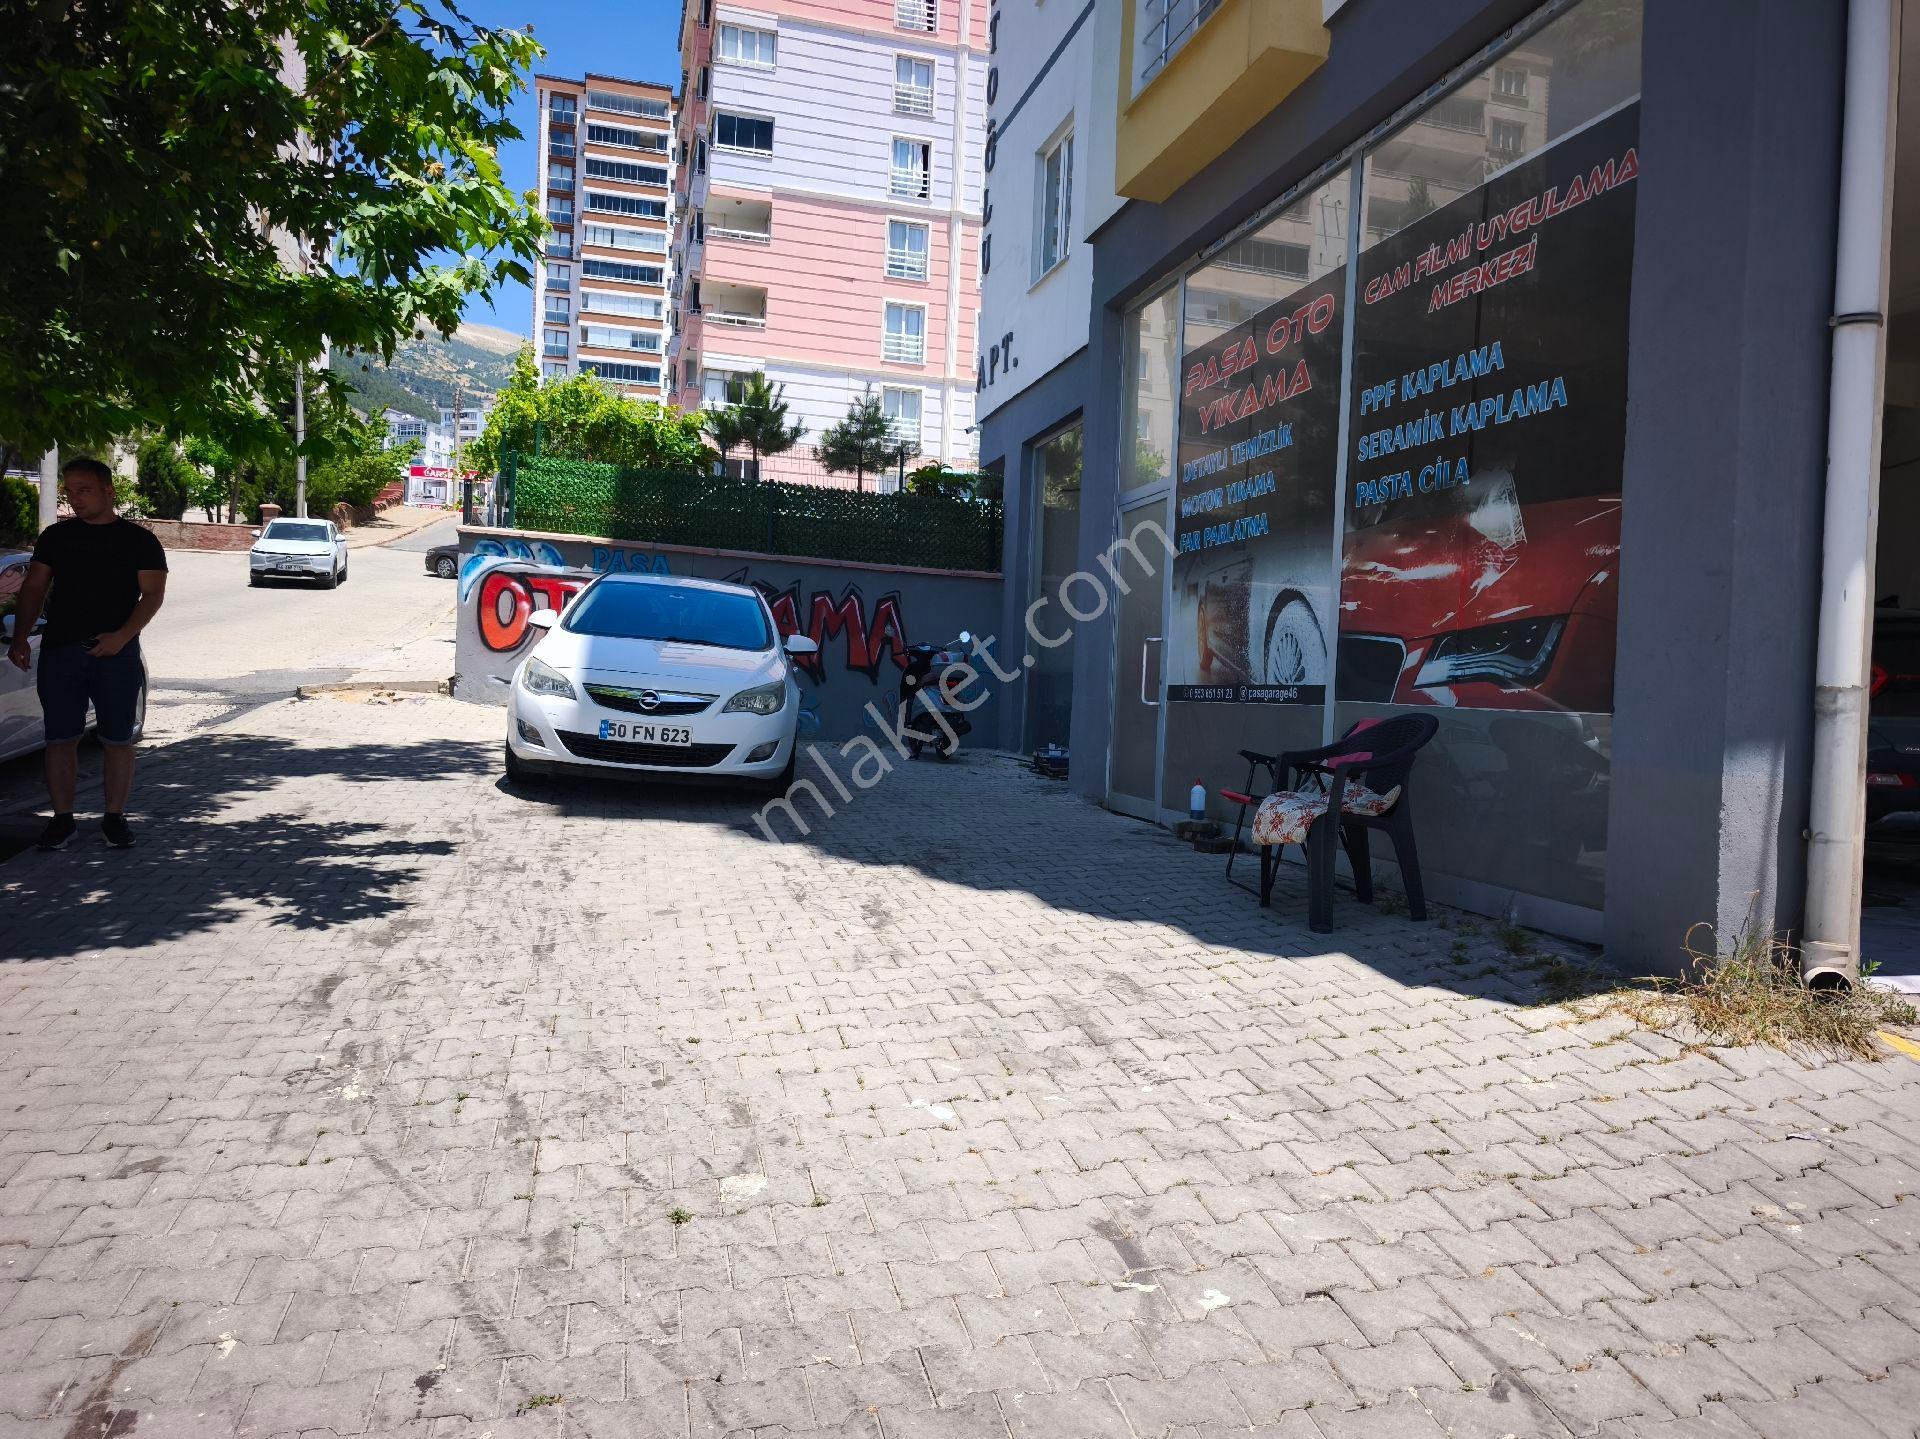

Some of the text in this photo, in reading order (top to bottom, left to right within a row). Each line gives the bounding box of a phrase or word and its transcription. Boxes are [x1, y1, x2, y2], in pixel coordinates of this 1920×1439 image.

[981, 0, 1001, 275] TOĞLU
[1363, 147, 1639, 305] CAM FİLMİ UYGULAMA
[1427, 232, 1538, 314] MERKEZİ
[975, 331, 1019, 394] APT.
[1184, 293, 1336, 398] PAŞA OTO
[1359, 340, 1505, 416] PPF KAPLAMA
[1198, 358, 1313, 435] YIKAMA
[1357, 376, 1568, 462] SERAMİK KAPLAMA
[1182, 420, 1294, 484] DETAYLI TEMİZLİK
[1355, 455, 1471, 509] PASTA CİLA
[1181, 470, 1276, 519] MOTOR YIKAMA
[1178, 512, 1271, 554] FAR PARLATMA
[477, 569, 598, 653] OT
[607, 722, 627, 739] 50
[632, 725, 656, 741] FN
[660, 727, 691, 744] 623
